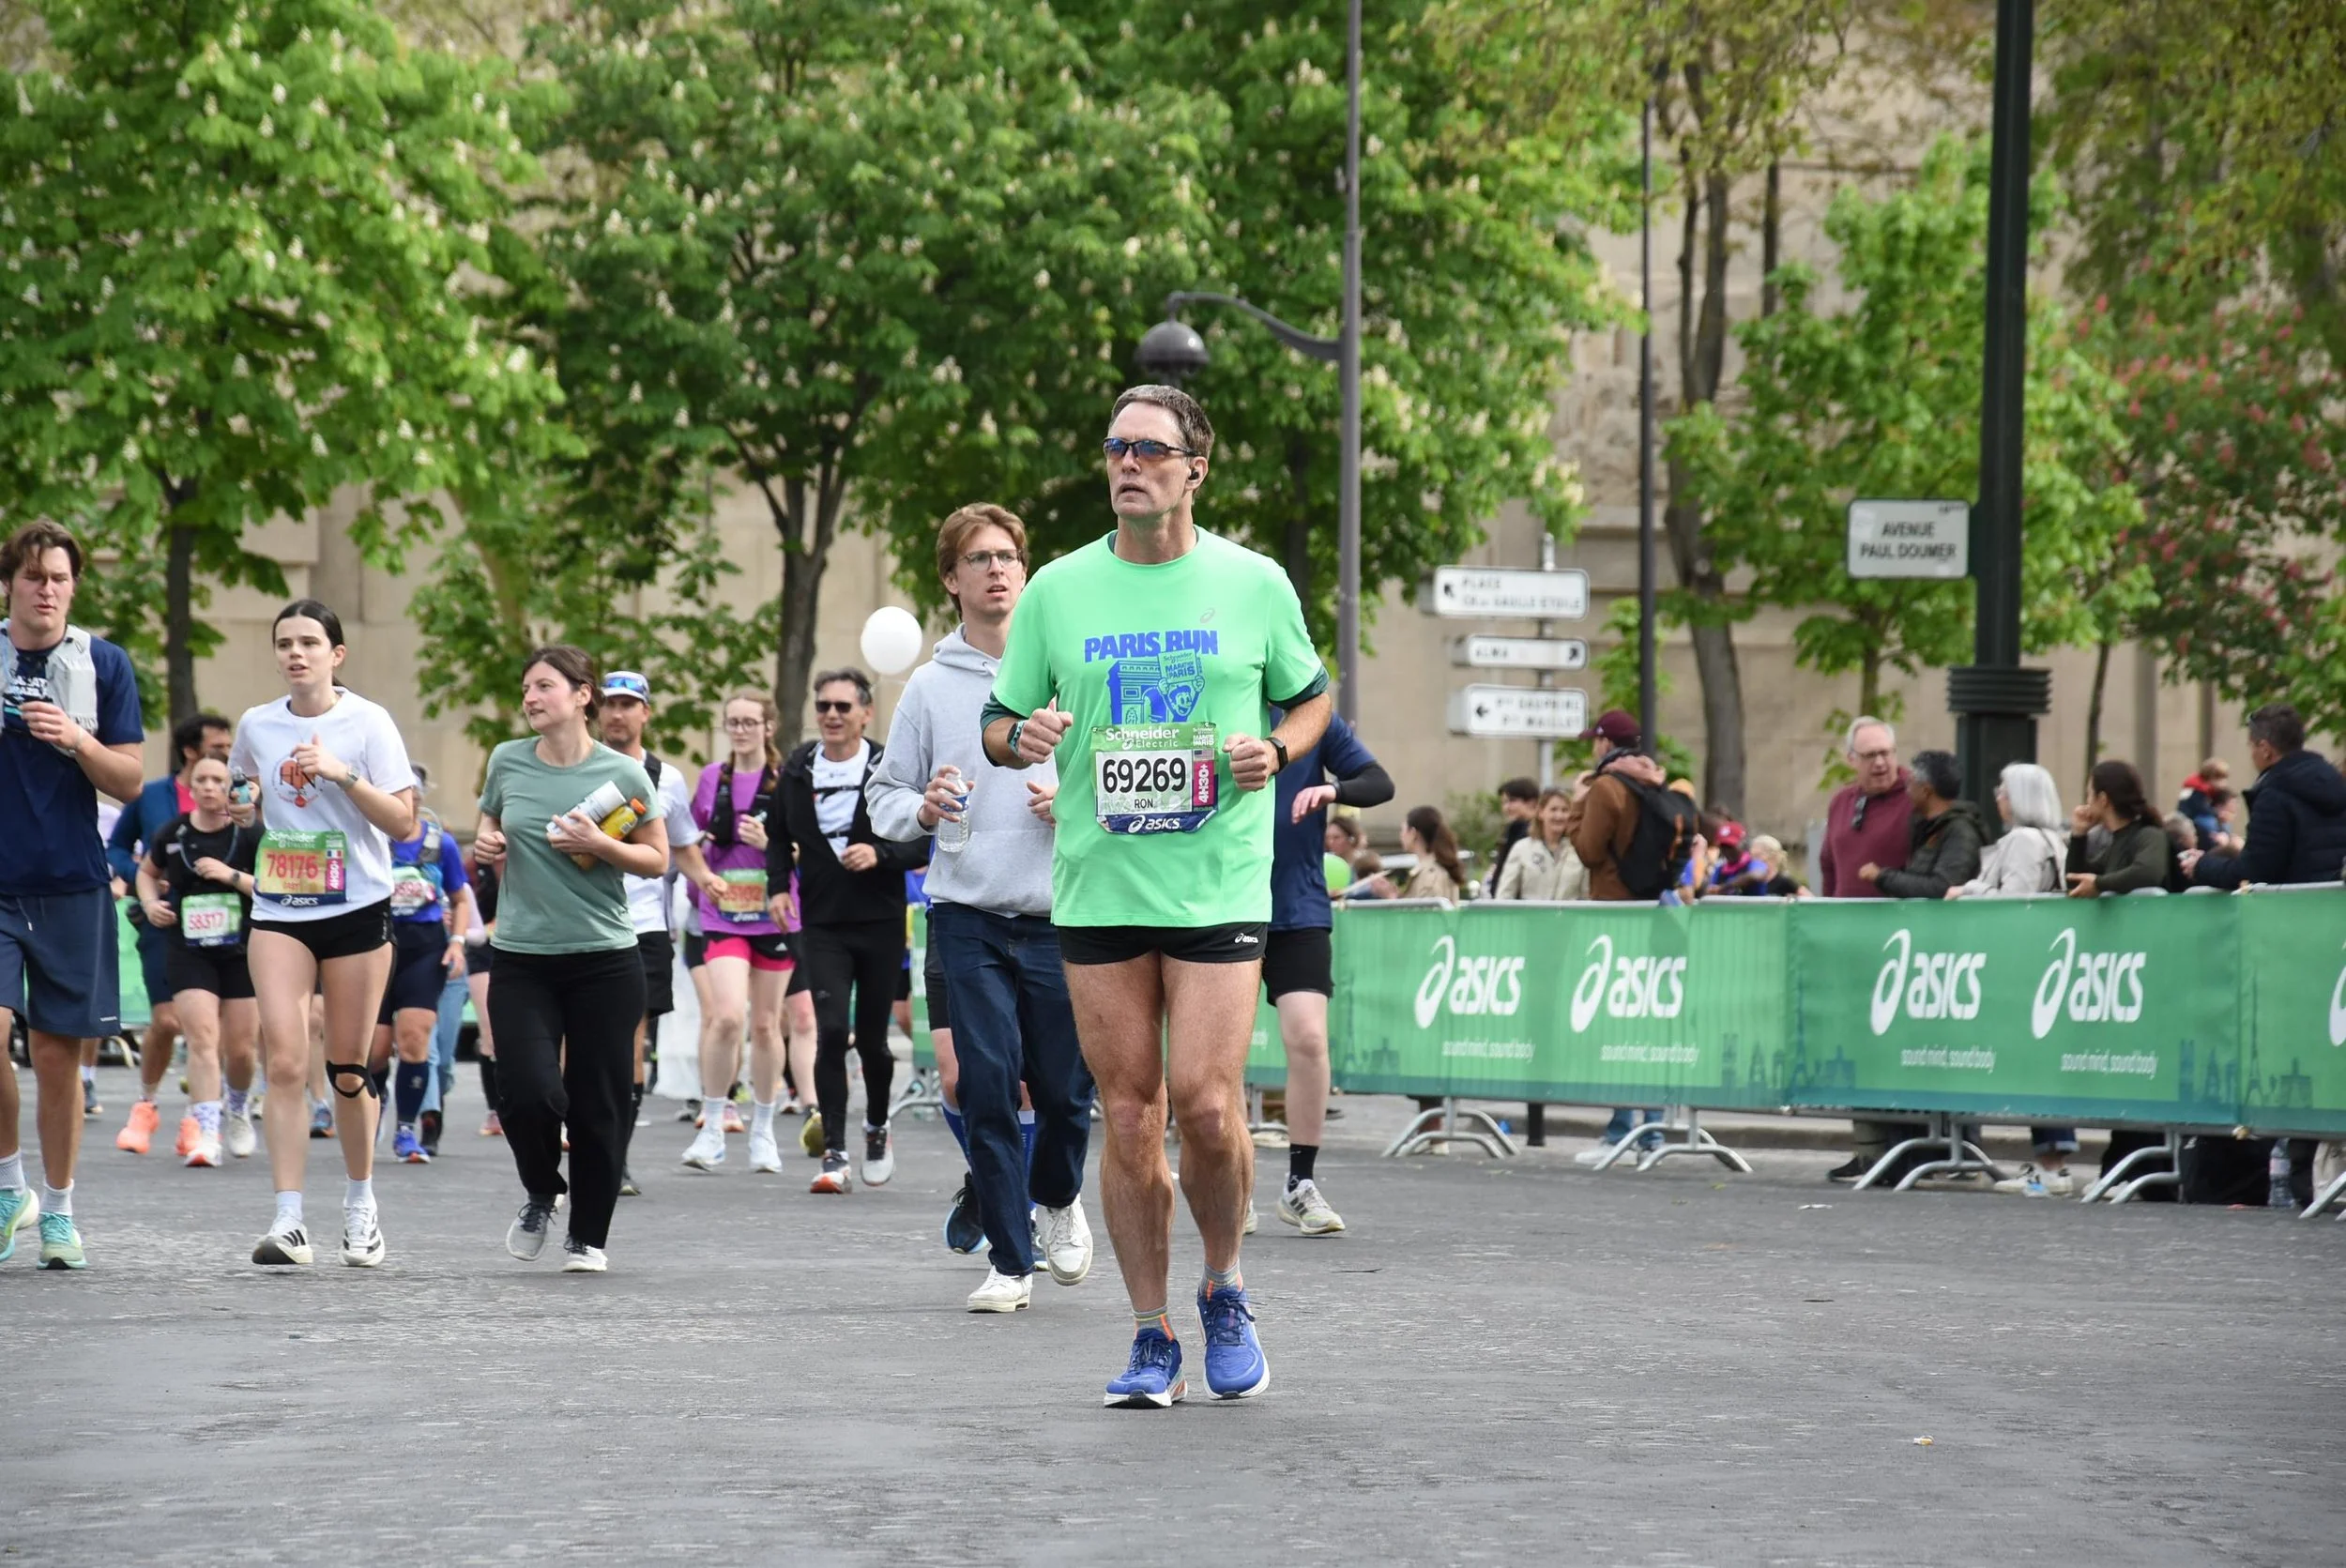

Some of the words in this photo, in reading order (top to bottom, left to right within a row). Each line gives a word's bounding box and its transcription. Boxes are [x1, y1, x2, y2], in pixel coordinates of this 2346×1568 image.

[1881, 521, 1936, 537] AVENUE
[1860, 542, 1894, 557] PAUL
[1897, 542, 1957, 559] DOUMER
[1084, 631, 1162, 663] PARIS
[1165, 630, 1219, 656] RUN
[1105, 726, 1180, 742] Schneider
[1135, 738, 1180, 749] Electric
[1102, 756, 1187, 794] 69269
[1197, 762, 1211, 804] 4H30+
[267, 830, 317, 844] Schneider
[267, 853, 319, 879] 78176
